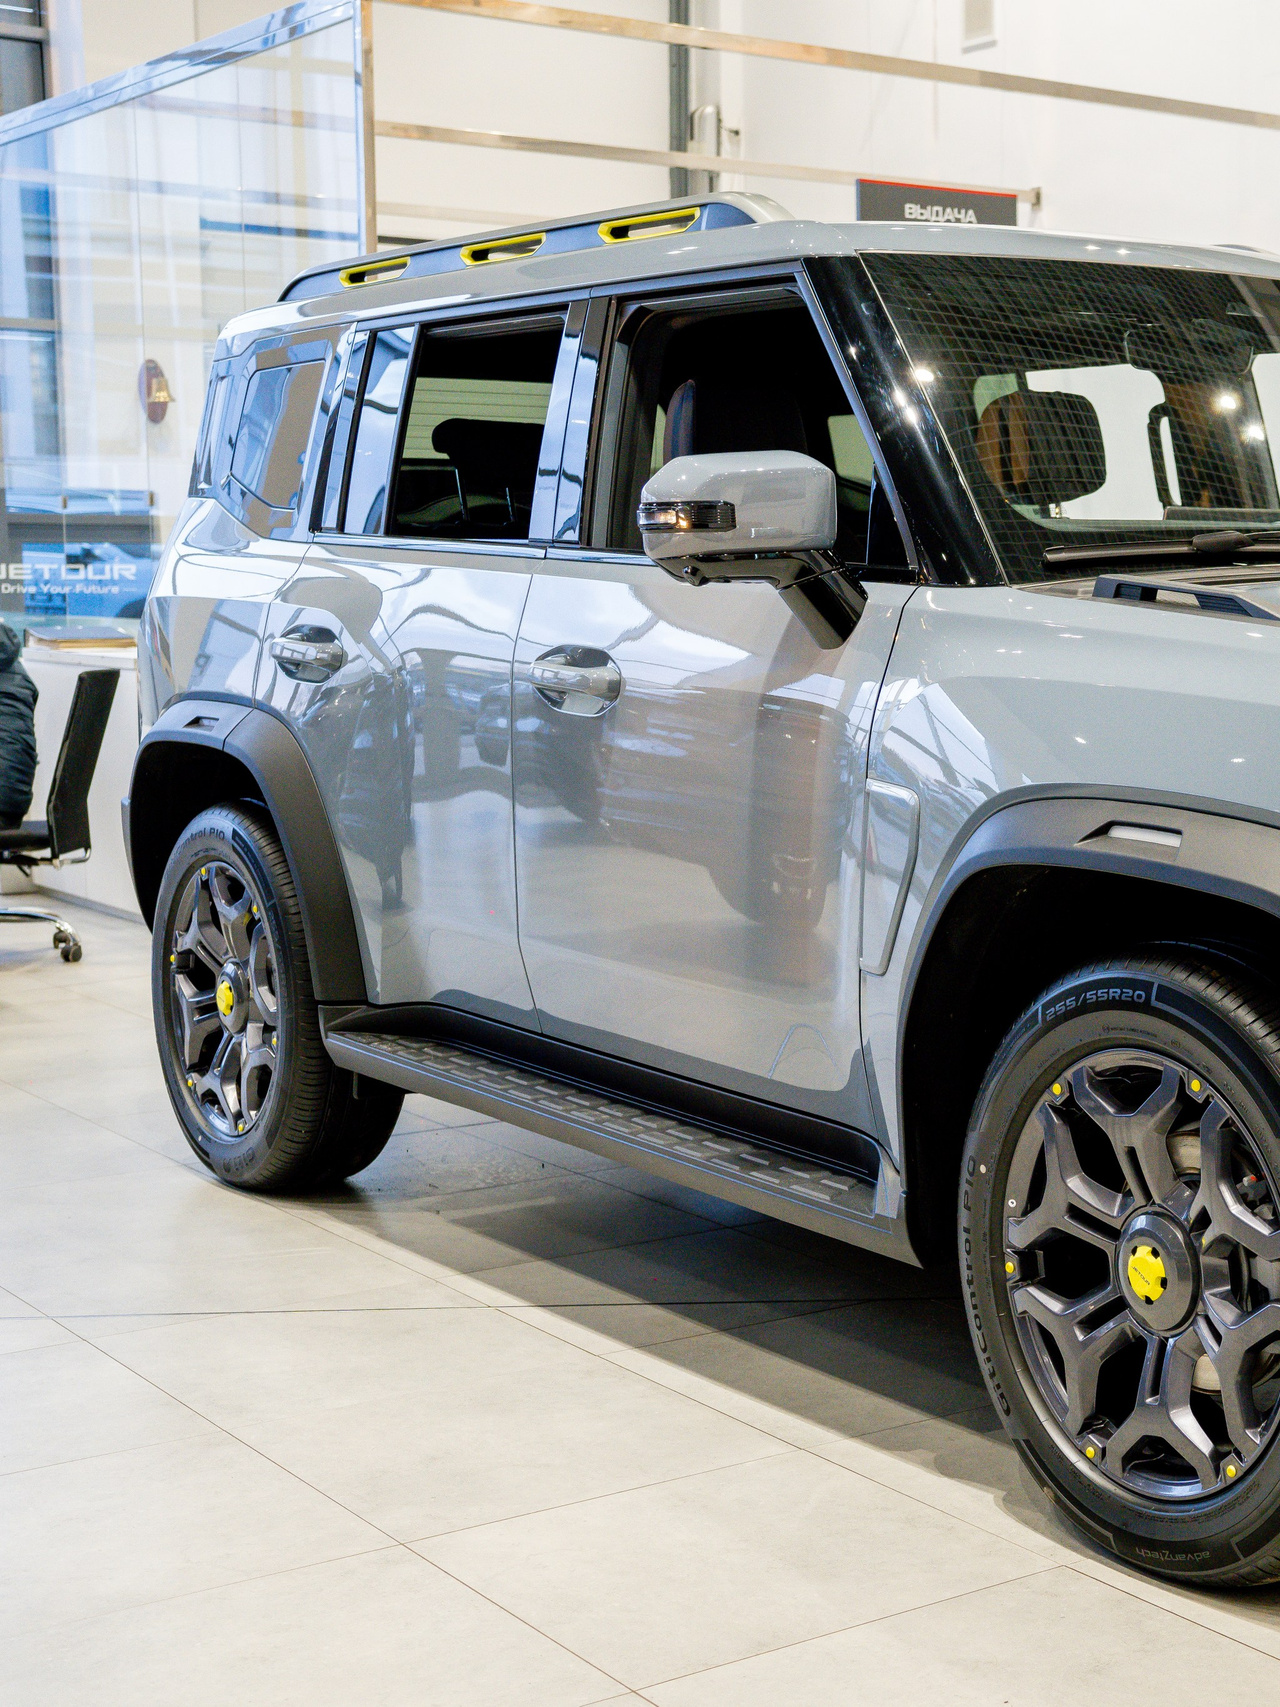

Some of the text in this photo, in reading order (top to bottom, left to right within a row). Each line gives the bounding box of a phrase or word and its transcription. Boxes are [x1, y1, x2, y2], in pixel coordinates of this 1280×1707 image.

[904, 202, 978, 225] ВЫДАЧА
[1, 582, 120, 595] Drive Your Future
[1045, 988, 1146, 1022] 255/55R20
